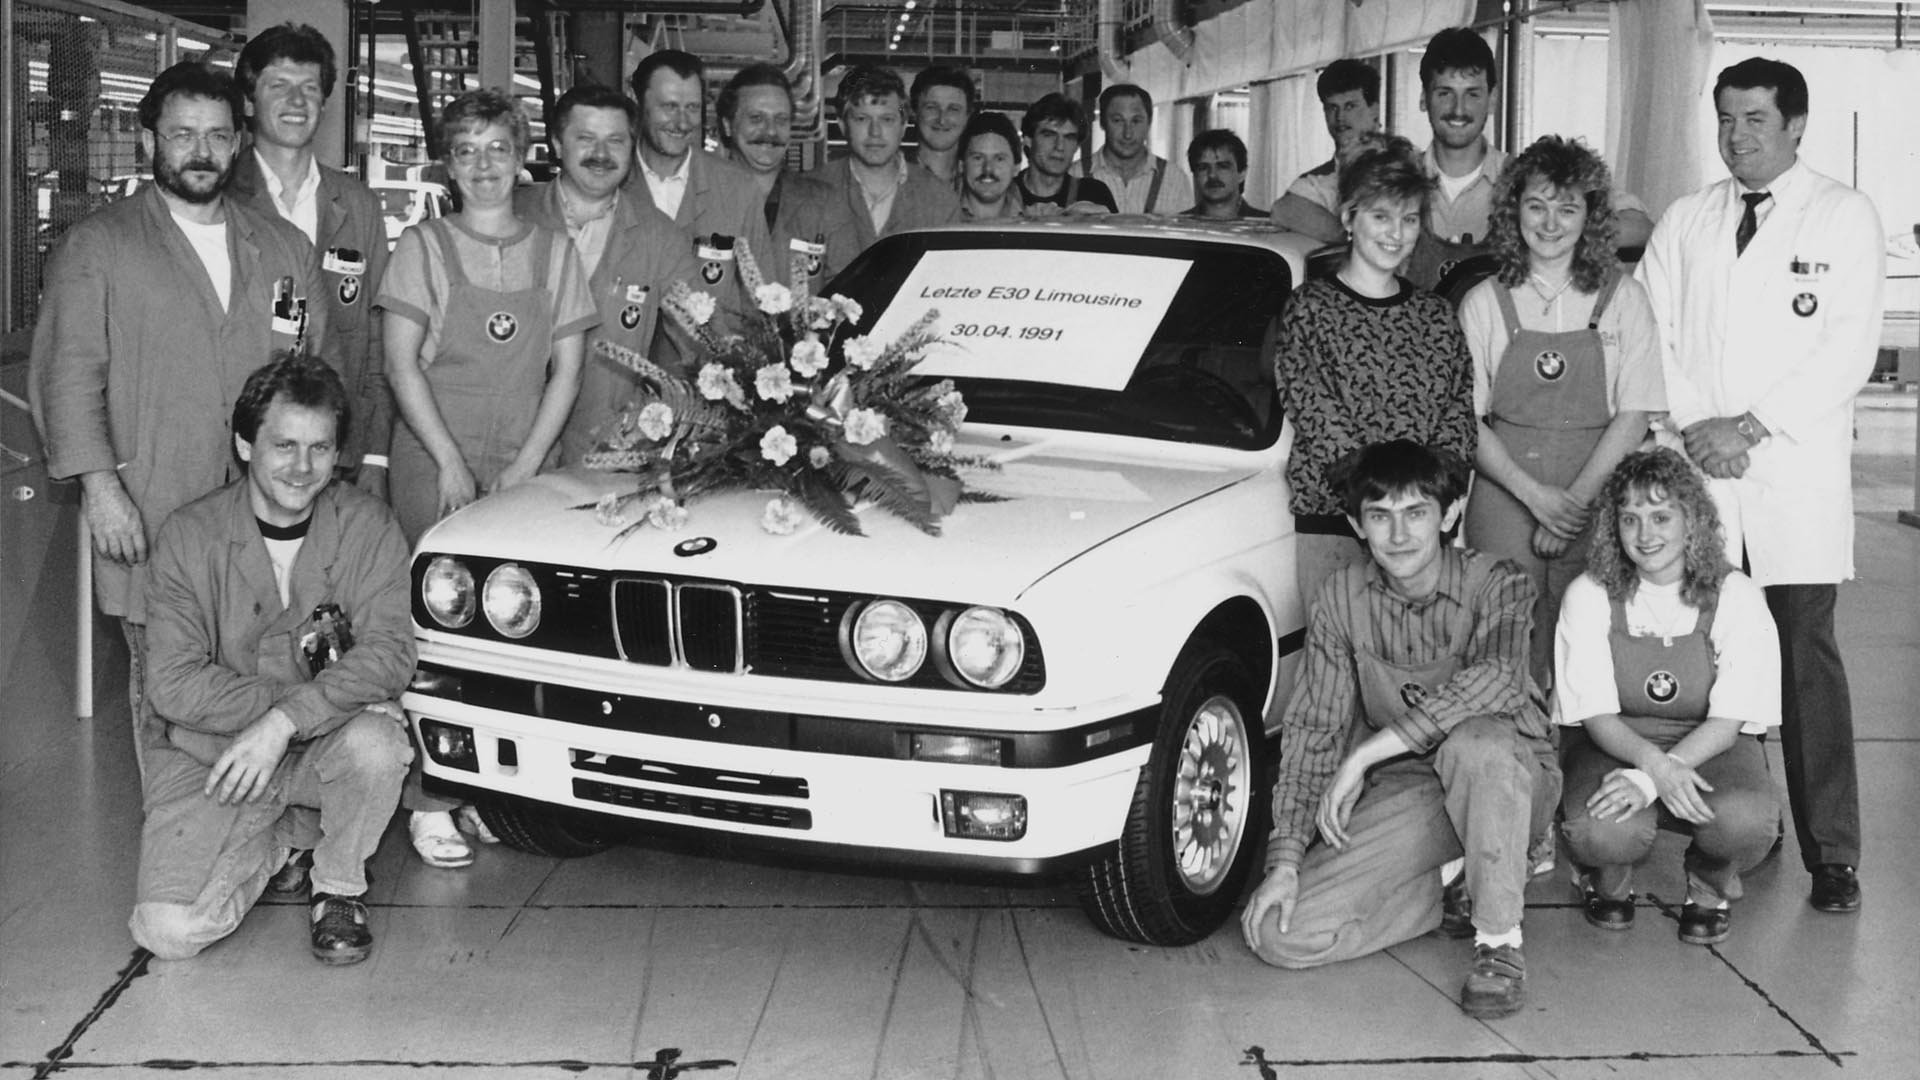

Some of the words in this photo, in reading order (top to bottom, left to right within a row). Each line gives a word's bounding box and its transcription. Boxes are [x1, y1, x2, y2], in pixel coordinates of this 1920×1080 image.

[919, 285, 982, 299] Letzte
[986, 286, 1031, 301] E30
[1034, 287, 1143, 309] Limousine
